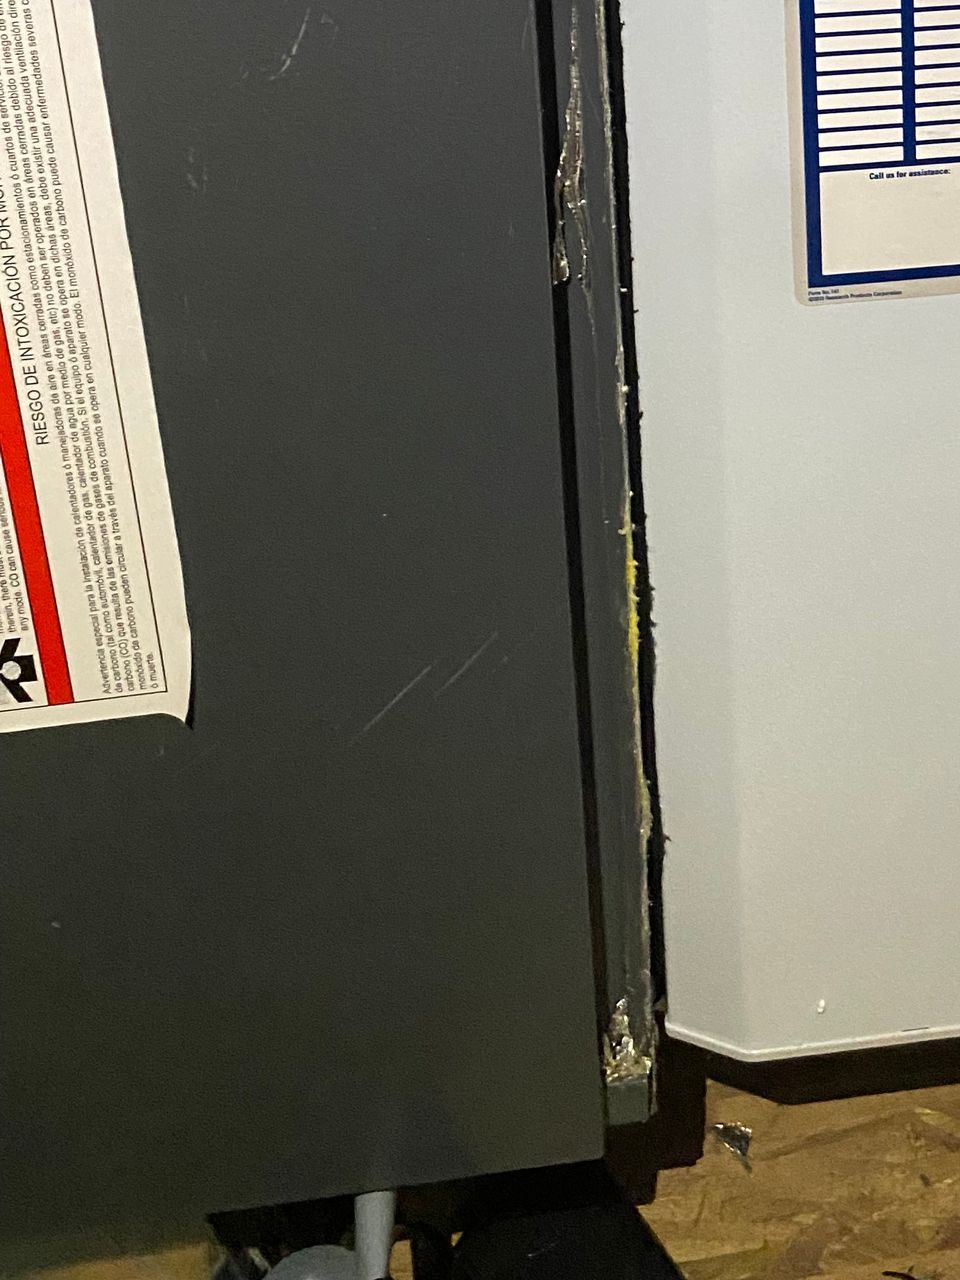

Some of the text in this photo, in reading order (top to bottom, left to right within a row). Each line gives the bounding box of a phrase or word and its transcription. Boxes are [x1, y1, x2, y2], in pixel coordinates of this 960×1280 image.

[23, 7, 36, 47] severas
[0, 33, 12, 64] riesgo
[11, 20, 27, 73] ventilación
[7, 77, 21, 111] debido
[20, 75, 36, 123] adecuada
[30, 49, 48, 119] enfermedades
[14, 113, 28, 155] cerradas
[29, 125, 40, 144] una
[41, 121, 55, 154] causar
[4, 136, 18, 172] cuartos
[32, 146, 45, 174] existir
[22, 157, 34, 184] áreas
[47, 156, 62, 186] puede
[869, 172, 884, 180] Call
[909, 168, 950, 177] assistance:
[38, 176, 49, 200] debe
[29, 200, 45, 244] operados
[43, 202, 55, 231] áreas,
[53, 188, 67, 226] carbono
[13, 182, 34, 263] estacionamientos
[37, 246, 47, 261] ser
[48, 233, 60, 264] dichas
[27, 265, 40, 291] como
[40, 262, 53, 292] deben
[62, 241, 77, 287] monóxido
[56, 279, 68, 306] opera
[32, 292, 47, 332] cerradas
[46, 307, 59, 325] etc)
[72, 300, 85, 329] modo.
[0, 254, 49, 445] RIESGO DE INTOXICACIÓN
[40, 333, 52, 358] áreas
[52, 326, 65, 346] gas,
[63, 320, 77, 355] aparato
[78, 330, 92, 371] cualquier
[47, 373, 57, 391] aire
[57, 361, 69, 389] medio
[71, 364, 84, 395] equipo
[62, 390, 75, 405] por
[88, 385, 100, 412] opera
[66, 407, 78, 429] agua
